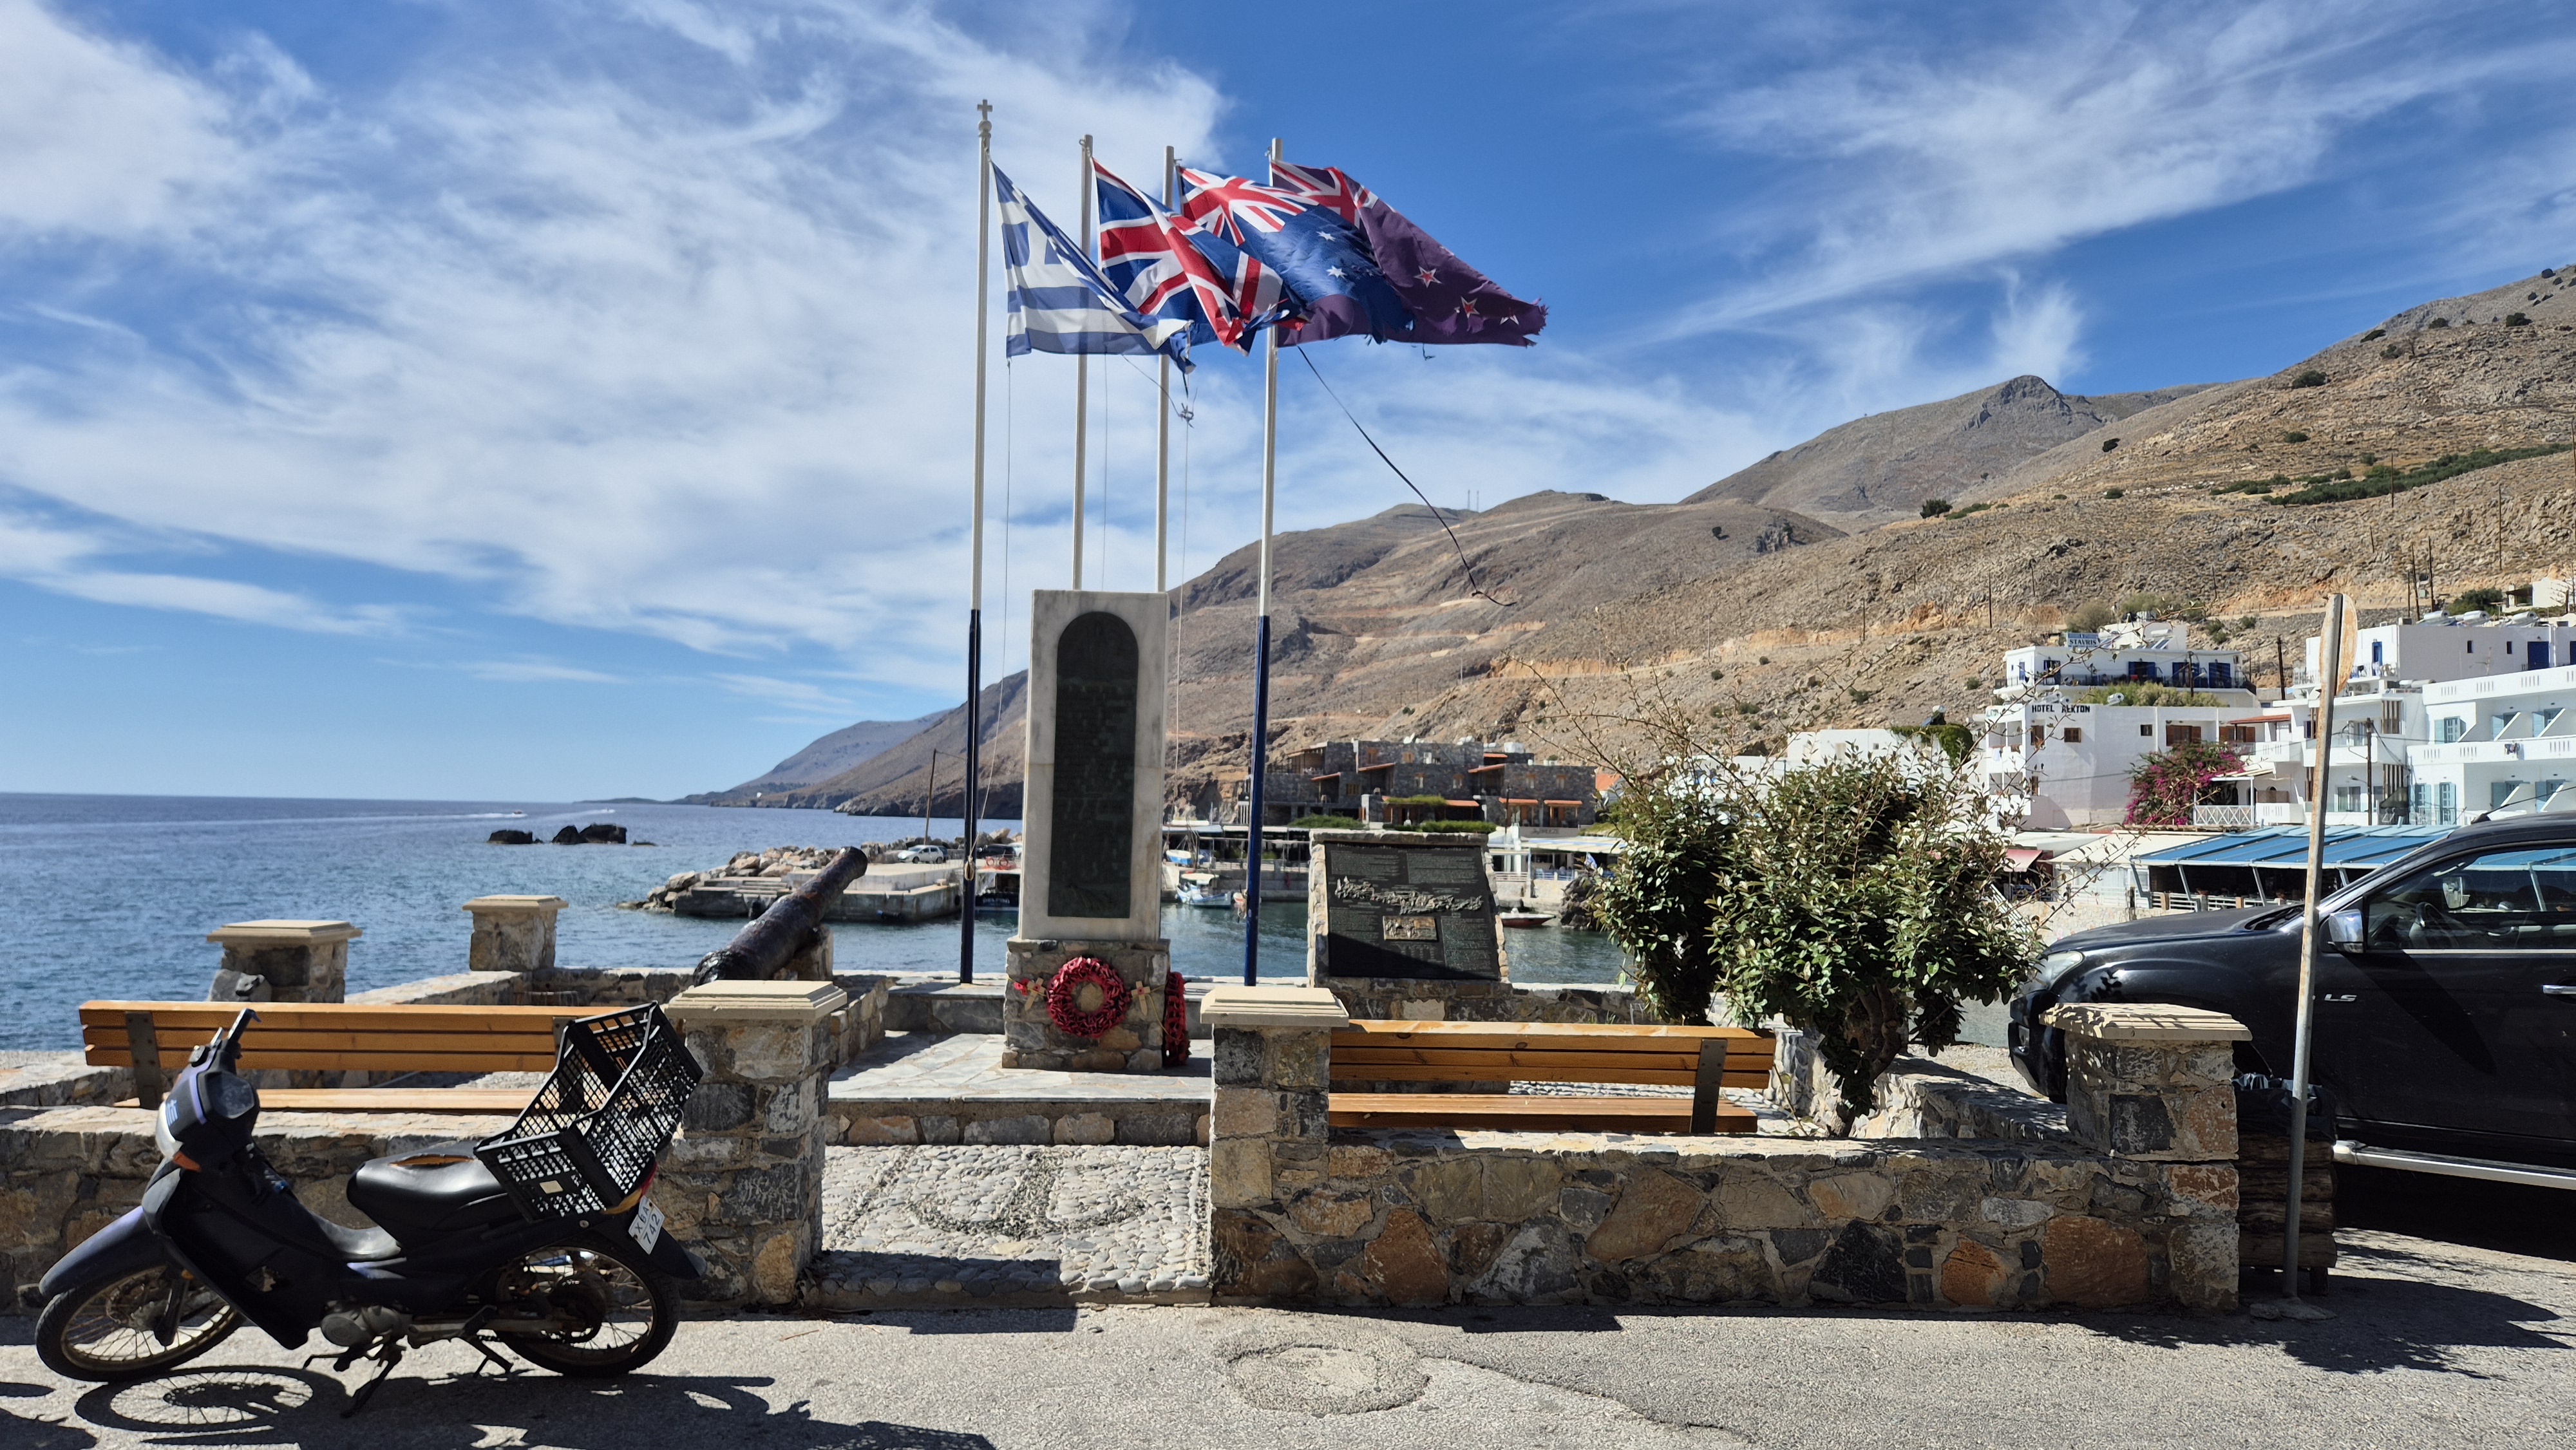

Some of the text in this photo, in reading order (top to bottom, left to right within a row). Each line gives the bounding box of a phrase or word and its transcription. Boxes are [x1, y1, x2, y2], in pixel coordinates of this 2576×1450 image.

[2032, 704, 2090, 713] HOTEL ALKYON
[2324, 993, 2358, 1002] LS
[635, 1206, 650, 1234] XBA
[643, 1214, 661, 1245] 742
